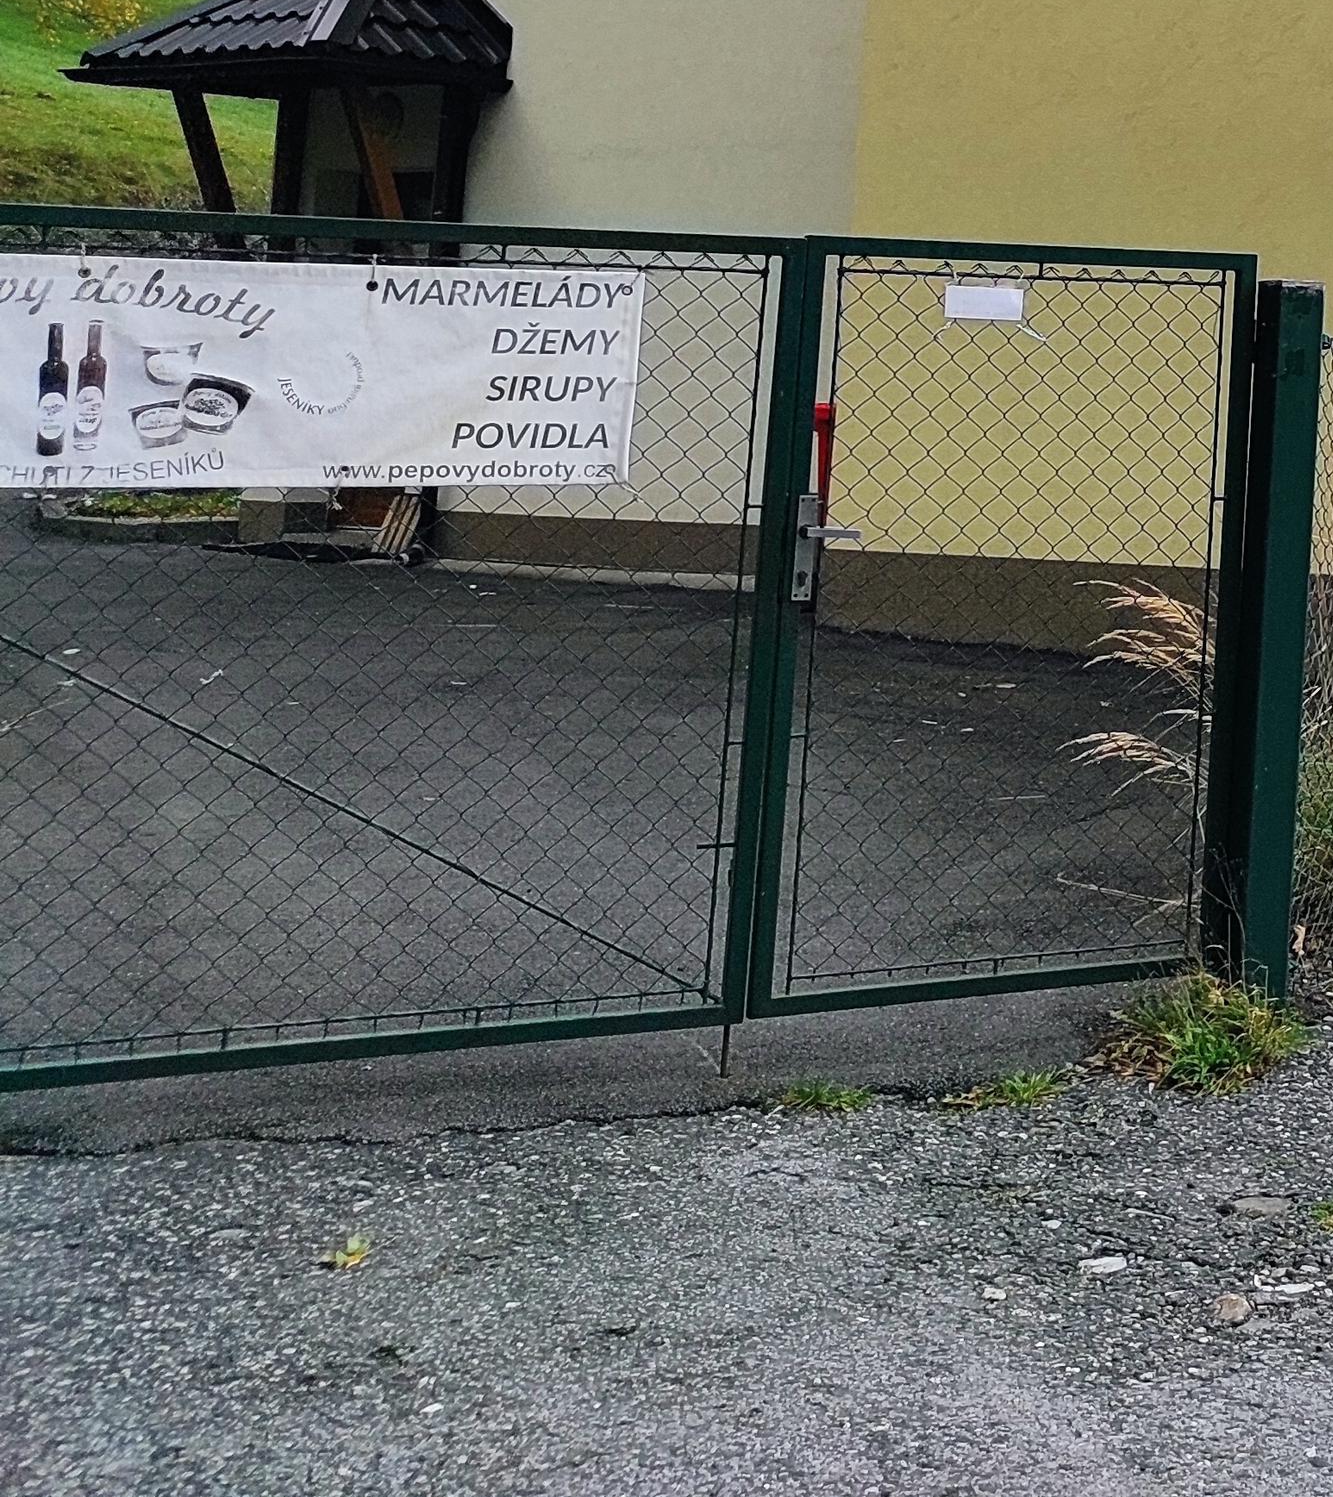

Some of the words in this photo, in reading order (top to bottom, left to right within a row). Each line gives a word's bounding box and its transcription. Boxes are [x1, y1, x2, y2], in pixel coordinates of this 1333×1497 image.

[71, 264, 275, 339] dobroty
[382, 275, 625, 308] MARMELÁDY
[491, 322, 620, 355] DŽEMY
[277, 377, 325, 415] JESENÍKY
[485, 375, 618, 403] SIRUPY
[451, 422, 610, 450] POVIDLA
[103, 447, 225, 484] JESENÍKŮ
[323, 459, 609, 483] www.pepovydobroty.cz
